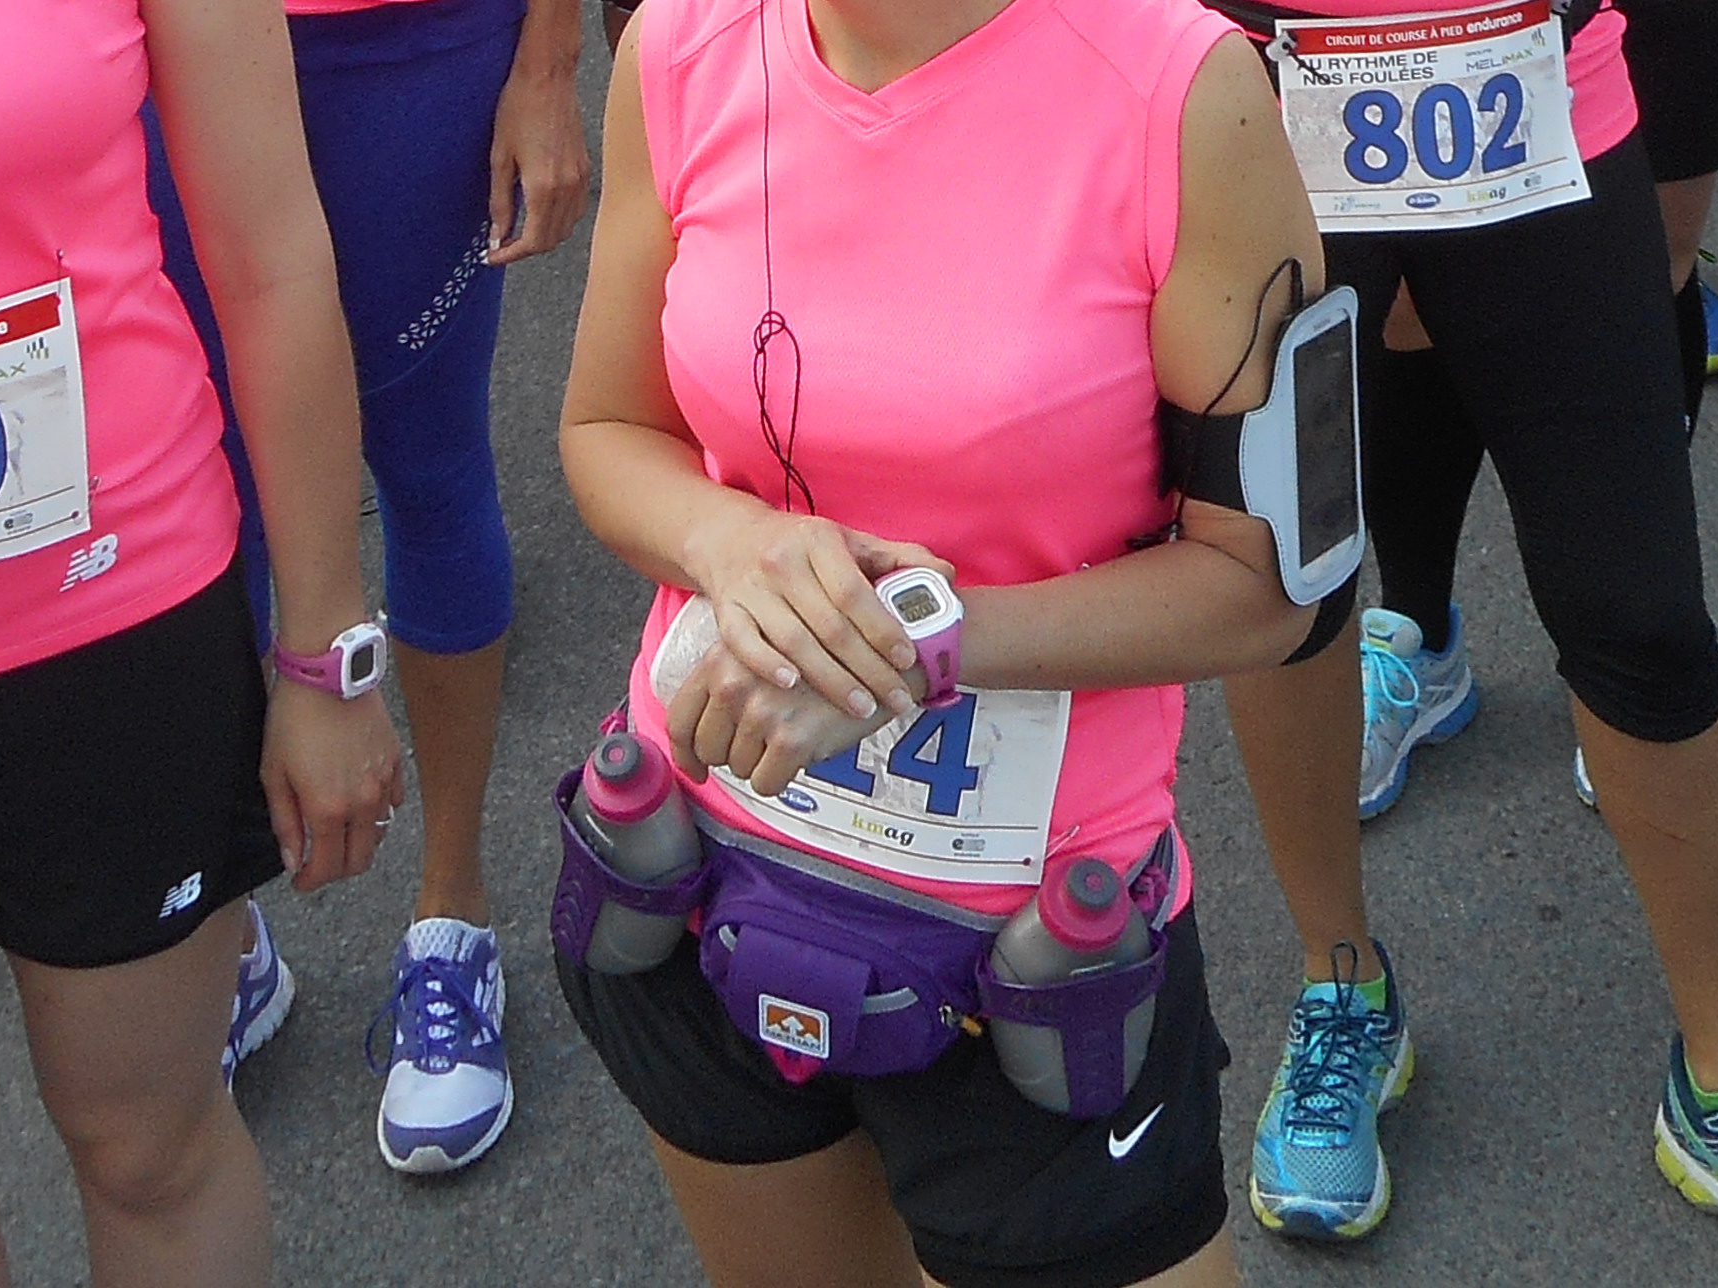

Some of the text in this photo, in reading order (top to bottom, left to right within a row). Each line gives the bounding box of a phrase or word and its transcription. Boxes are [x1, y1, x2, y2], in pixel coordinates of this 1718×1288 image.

[1326, 12, 1523, 47] CIRCUIT DE COURSE À PIED endurance
[1297, 51, 1439, 71] AU RYTHME DE
[1466, 48, 1533, 72] MELIMAX
[1303, 66, 1434, 86] NOS FOULÉES
[1343, 72, 1527, 185] 802
